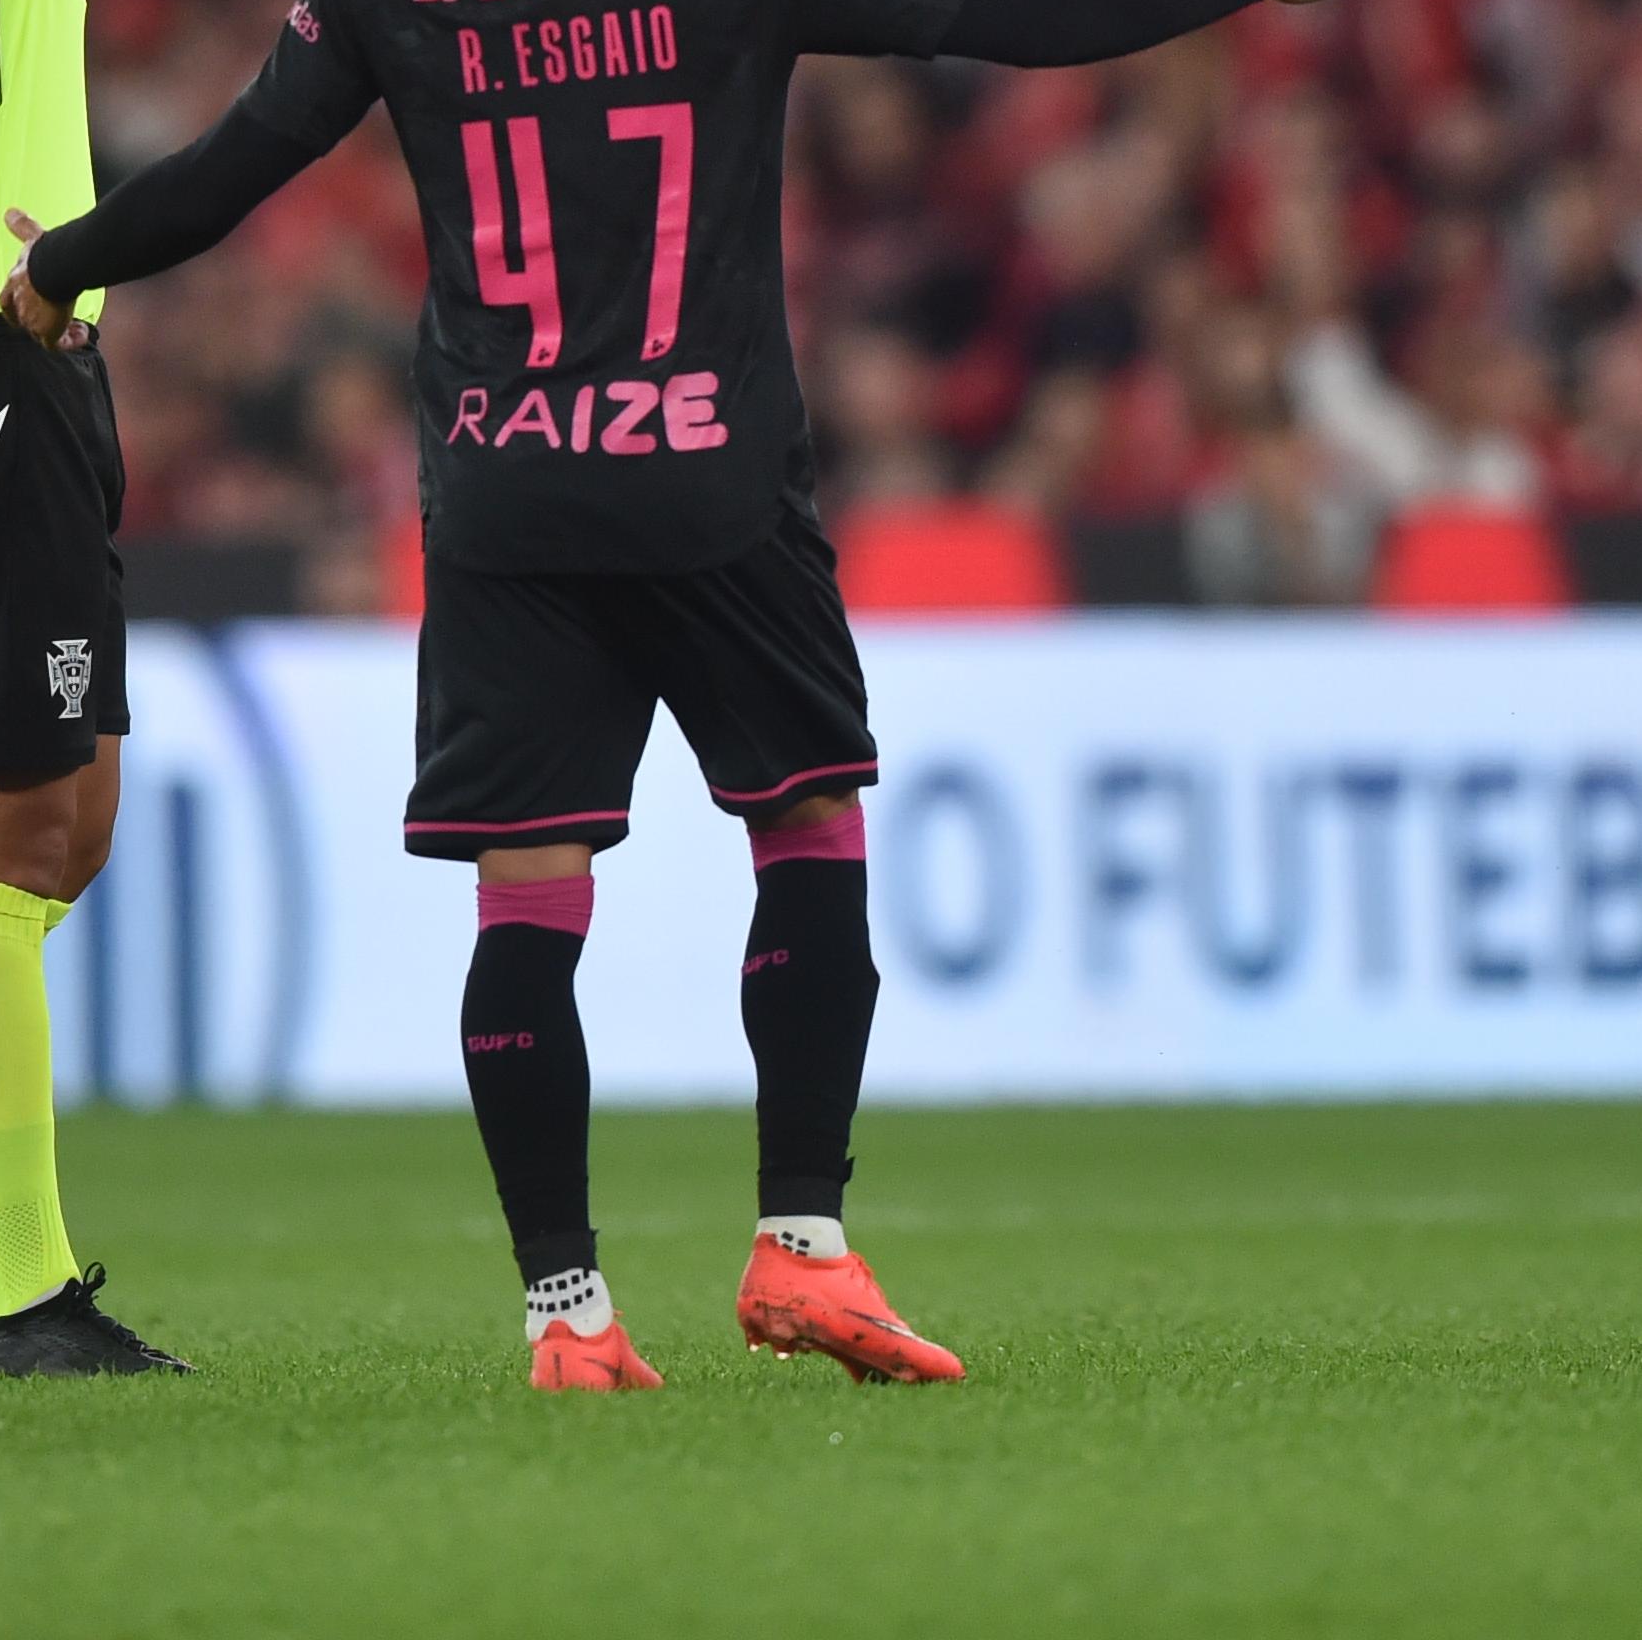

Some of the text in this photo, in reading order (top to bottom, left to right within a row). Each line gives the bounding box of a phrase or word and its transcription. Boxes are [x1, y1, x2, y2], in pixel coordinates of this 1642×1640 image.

[458, 4, 678, 93] R. ESGAIO
[460, 102, 694, 368] 47
[447, 370, 728, 455] RAIZE
